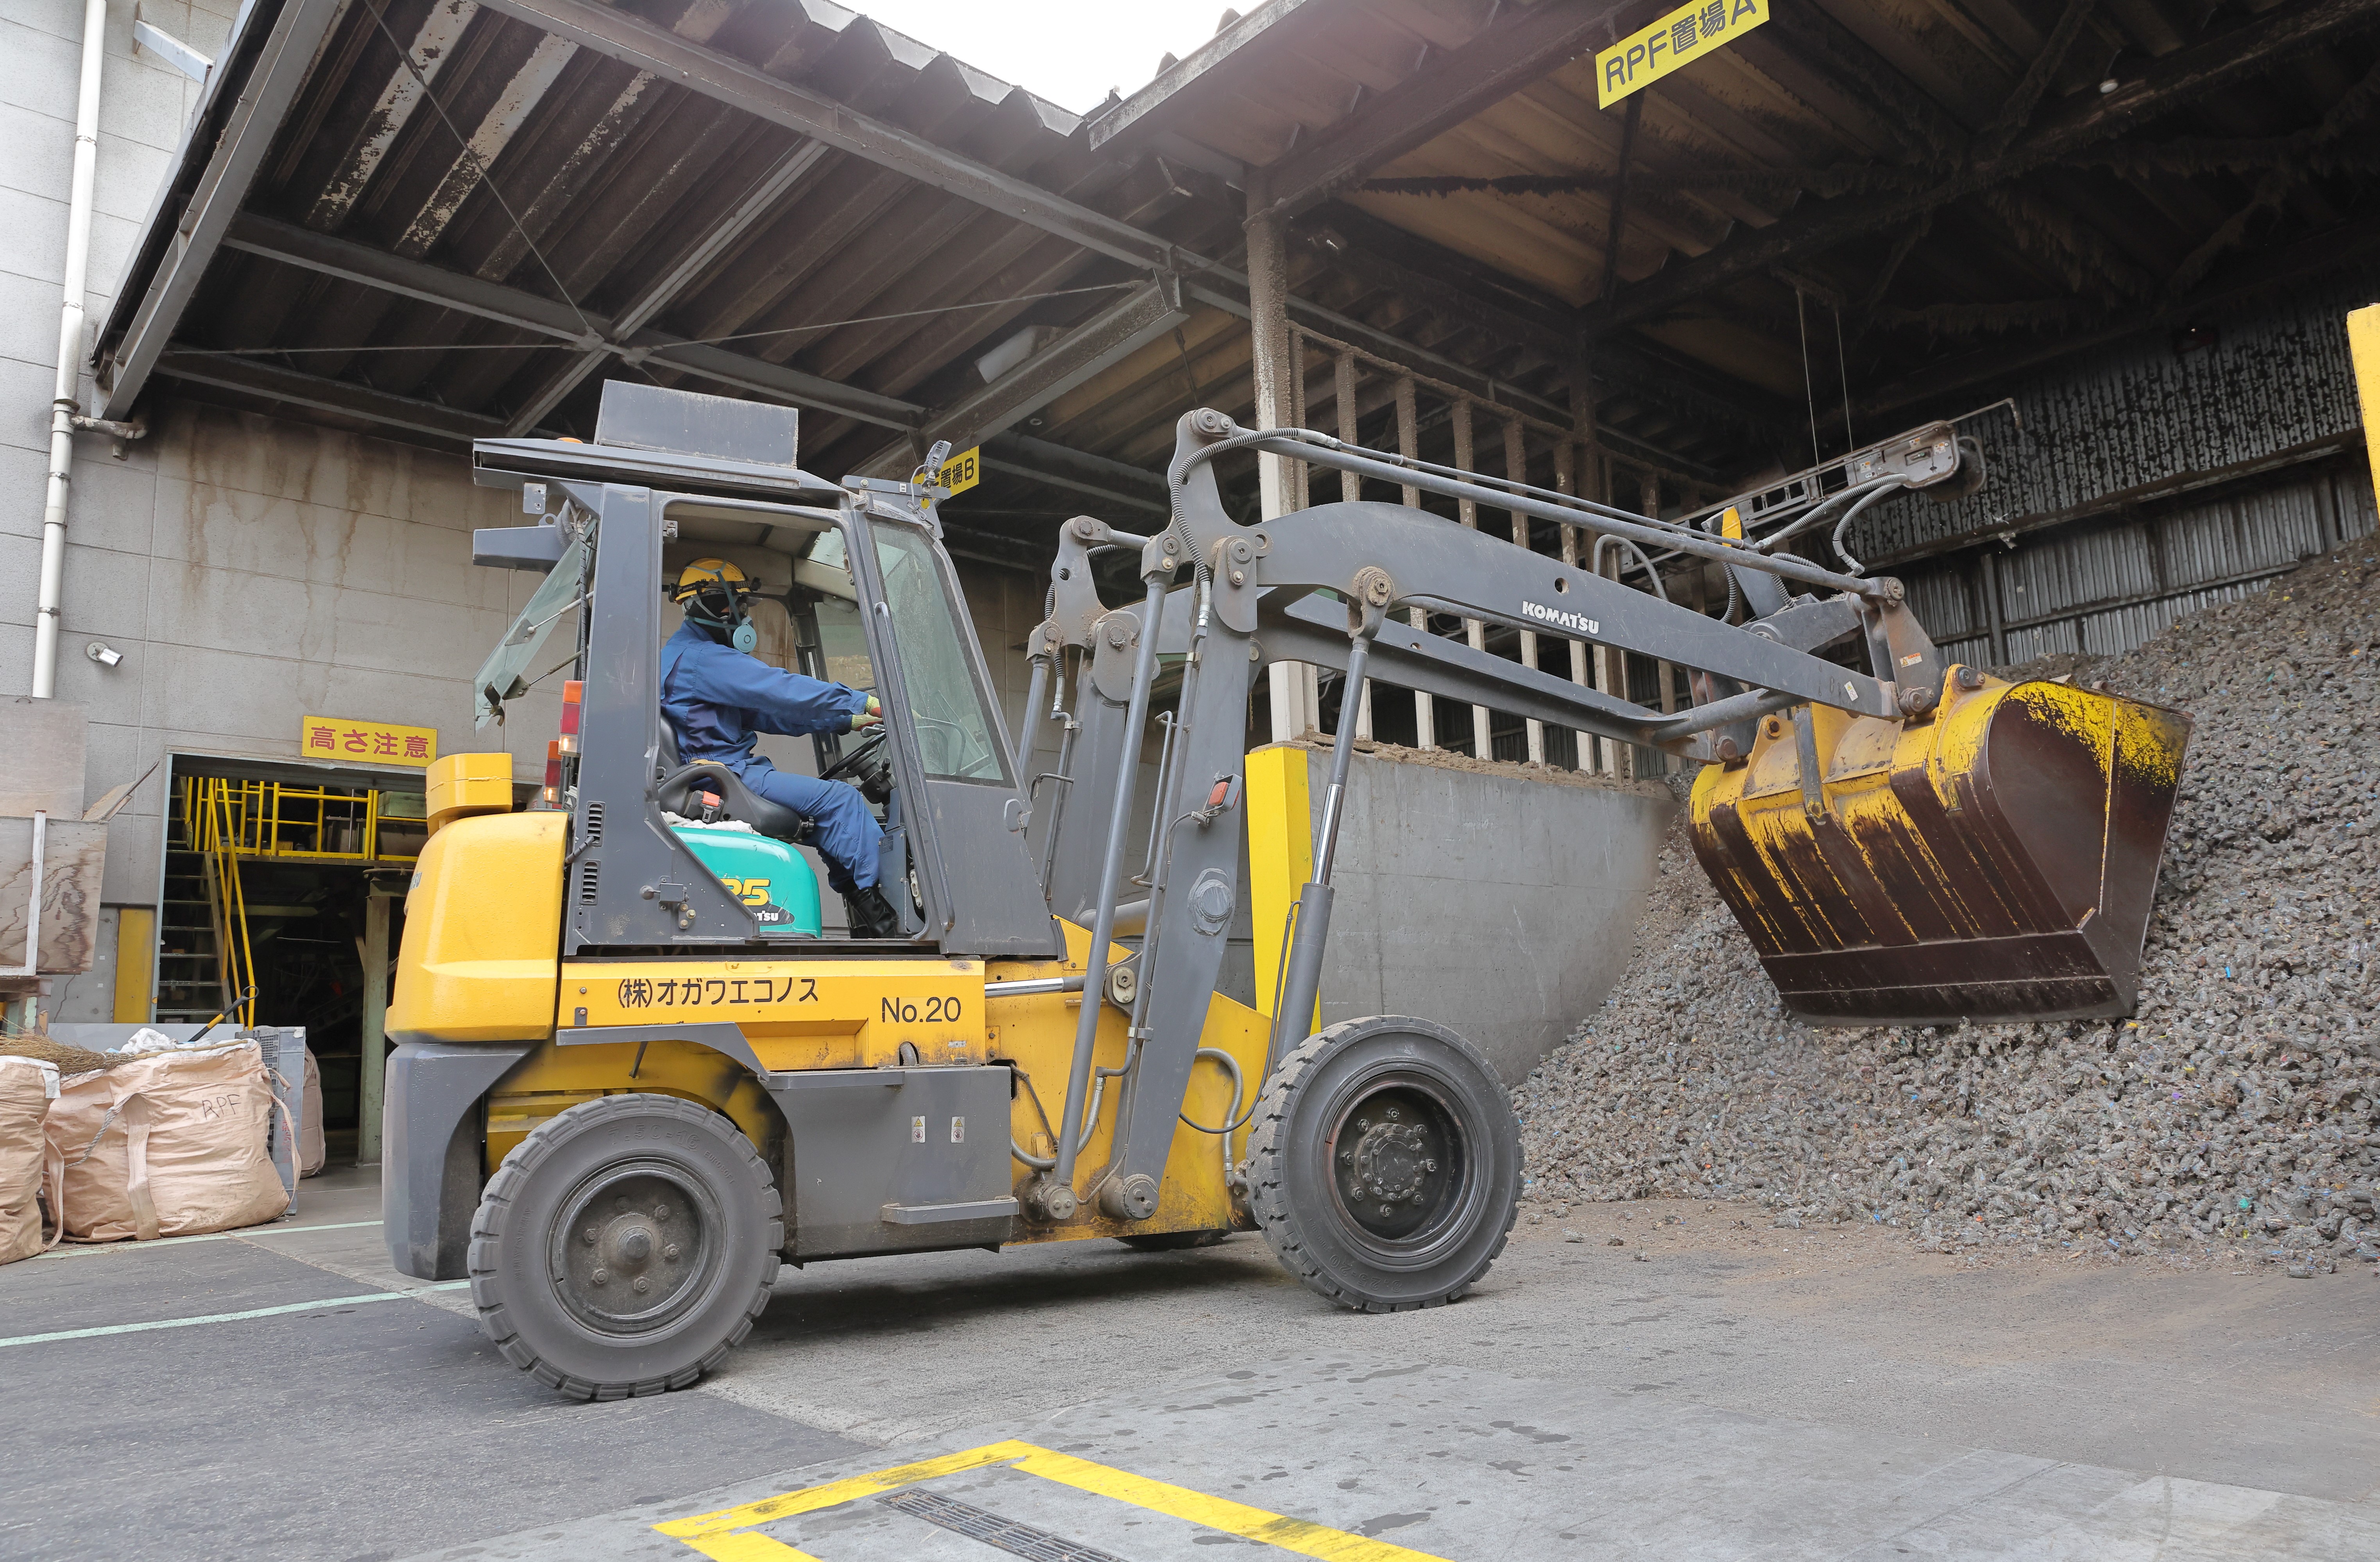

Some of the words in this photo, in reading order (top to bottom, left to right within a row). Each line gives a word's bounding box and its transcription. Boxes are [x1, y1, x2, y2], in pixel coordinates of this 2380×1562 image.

[1606, 0, 1757, 92] RPF置場A
[918, 457, 974, 488] 置場B
[1522, 600, 1599, 634] KOMATSU
[310, 726, 429, 758] 高さ注意
[753, 910, 779, 921] TSU
[618, 977, 818, 1008] (株)オガワエコノス
[882, 997, 961, 1023] No.20
[202, 1094, 242, 1120] RPF
